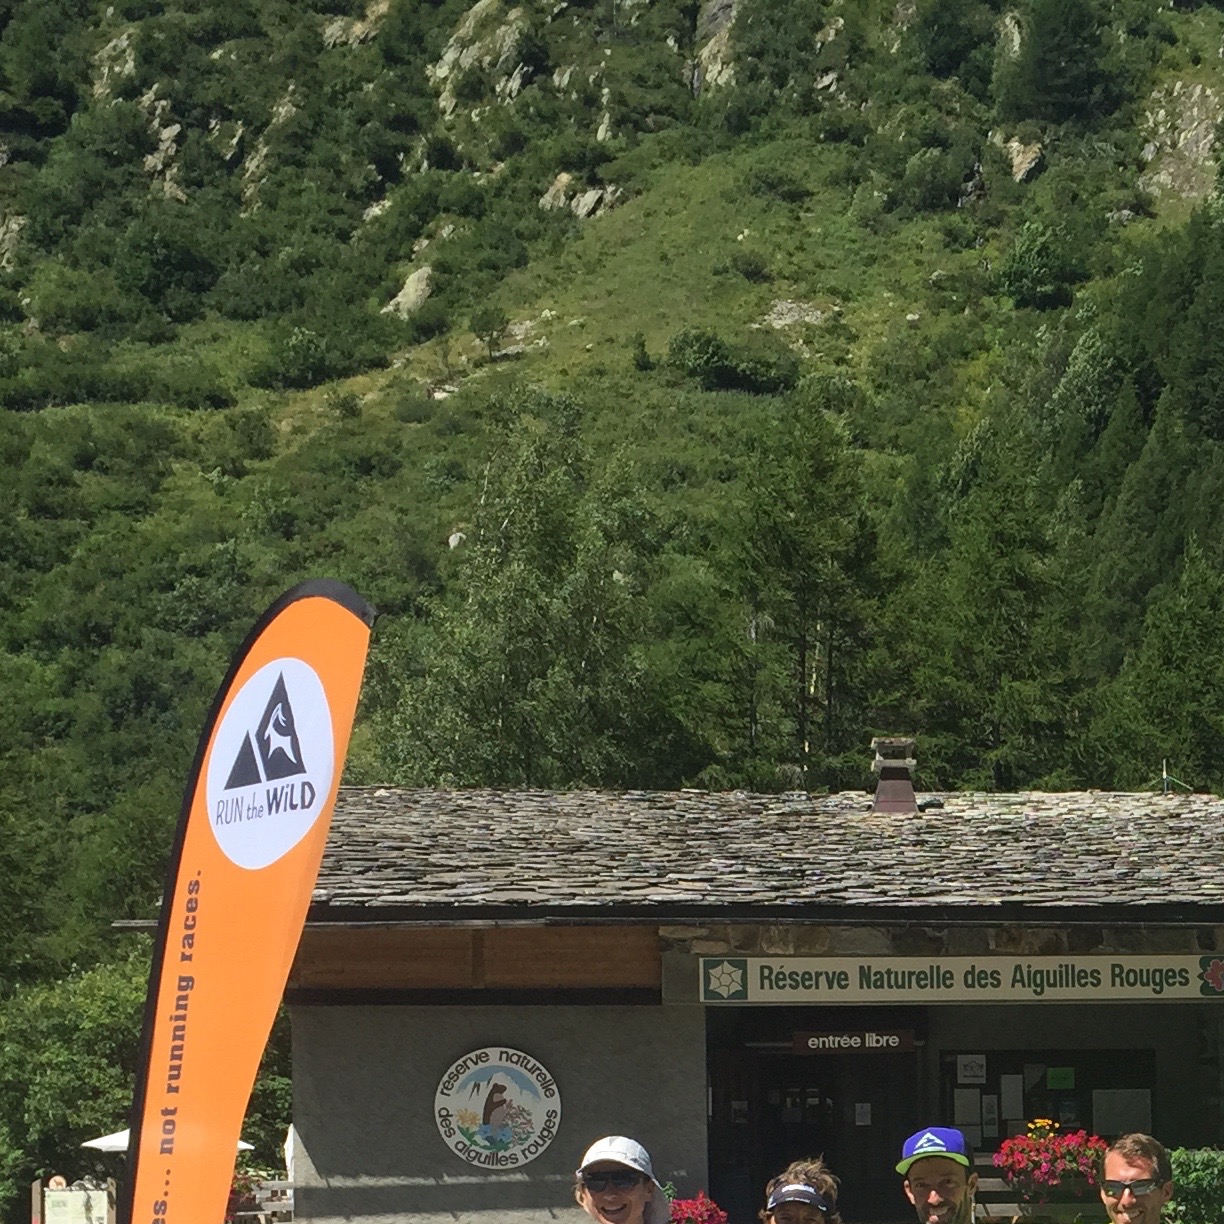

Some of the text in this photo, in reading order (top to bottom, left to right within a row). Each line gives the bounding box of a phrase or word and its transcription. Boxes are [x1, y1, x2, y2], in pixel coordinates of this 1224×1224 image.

[215, 796, 244, 825] RUN
[246, 792, 264, 820] the
[180, 869, 202, 962] races.
[759, 962, 1190, 995] Réserve Naturelle des Aiguilles Rouges
[166, 975, 195, 1094] running
[808, 1032, 900, 1049] entrée libre
[440, 1050, 556, 1098] reserve naturelle
[160, 1106, 178, 1155] not
[438, 1107, 558, 1166] des aiguilles rouges
